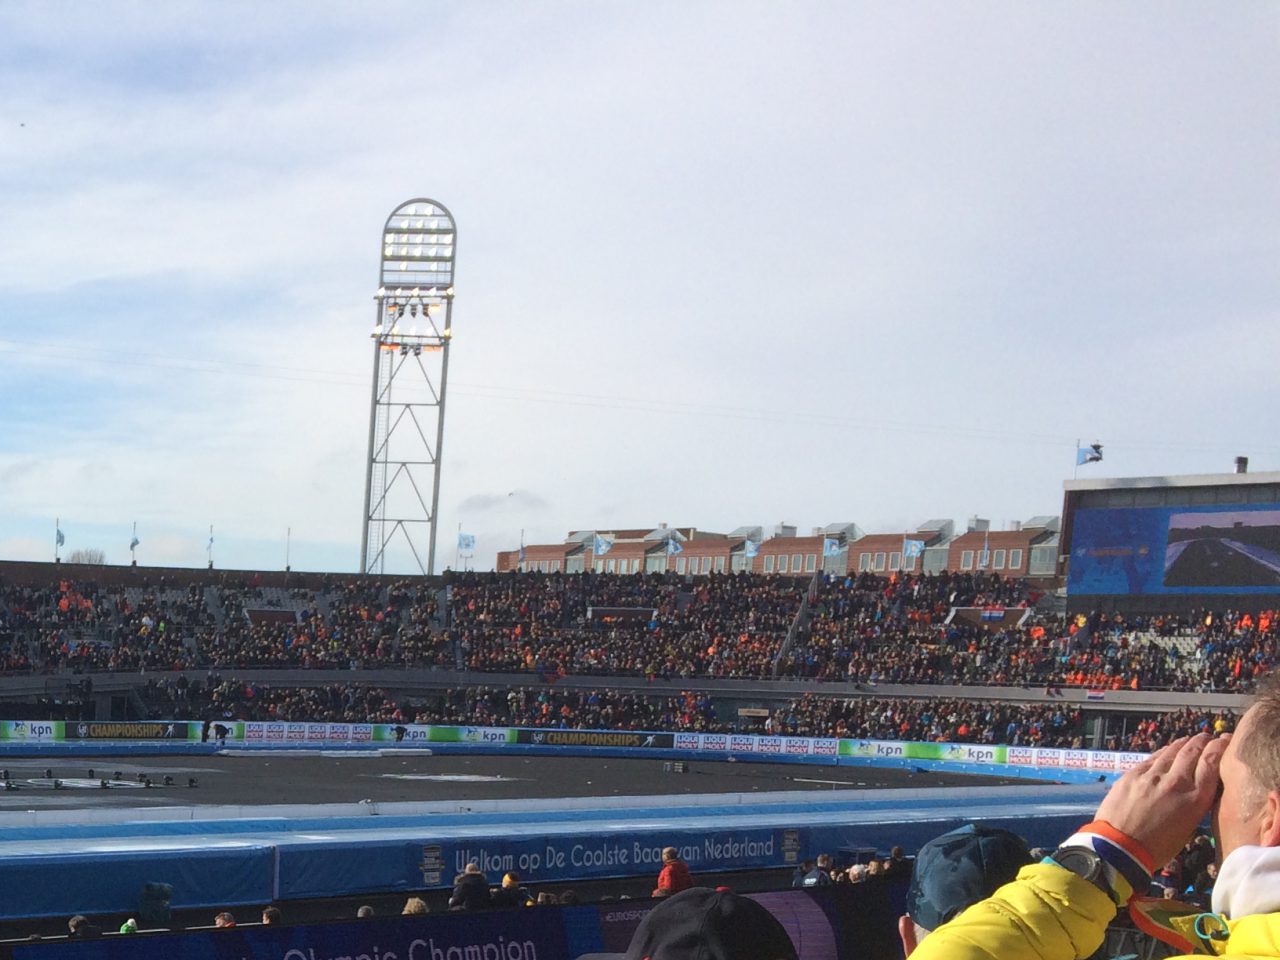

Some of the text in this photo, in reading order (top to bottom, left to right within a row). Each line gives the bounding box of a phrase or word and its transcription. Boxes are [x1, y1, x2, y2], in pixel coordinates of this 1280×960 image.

[30, 723, 52, 738] kpn
[89, 724, 163, 737] CHAMPIONSHIPS
[404, 729, 426, 741] kpn
[482, 730, 505, 744] kpn
[547, 733, 640, 746] CHAMPIONSHIPS
[877, 743, 903, 756] kpn
[968, 748, 993, 762] kpn
[455, 849, 513, 873] Welkom
[518, 853, 540, 873] op
[546, 846, 566, 869] De
[570, 843, 629, 867] Coolste
[633, 842, 661, 864] Baa
[705, 835, 774, 860] Nederland
